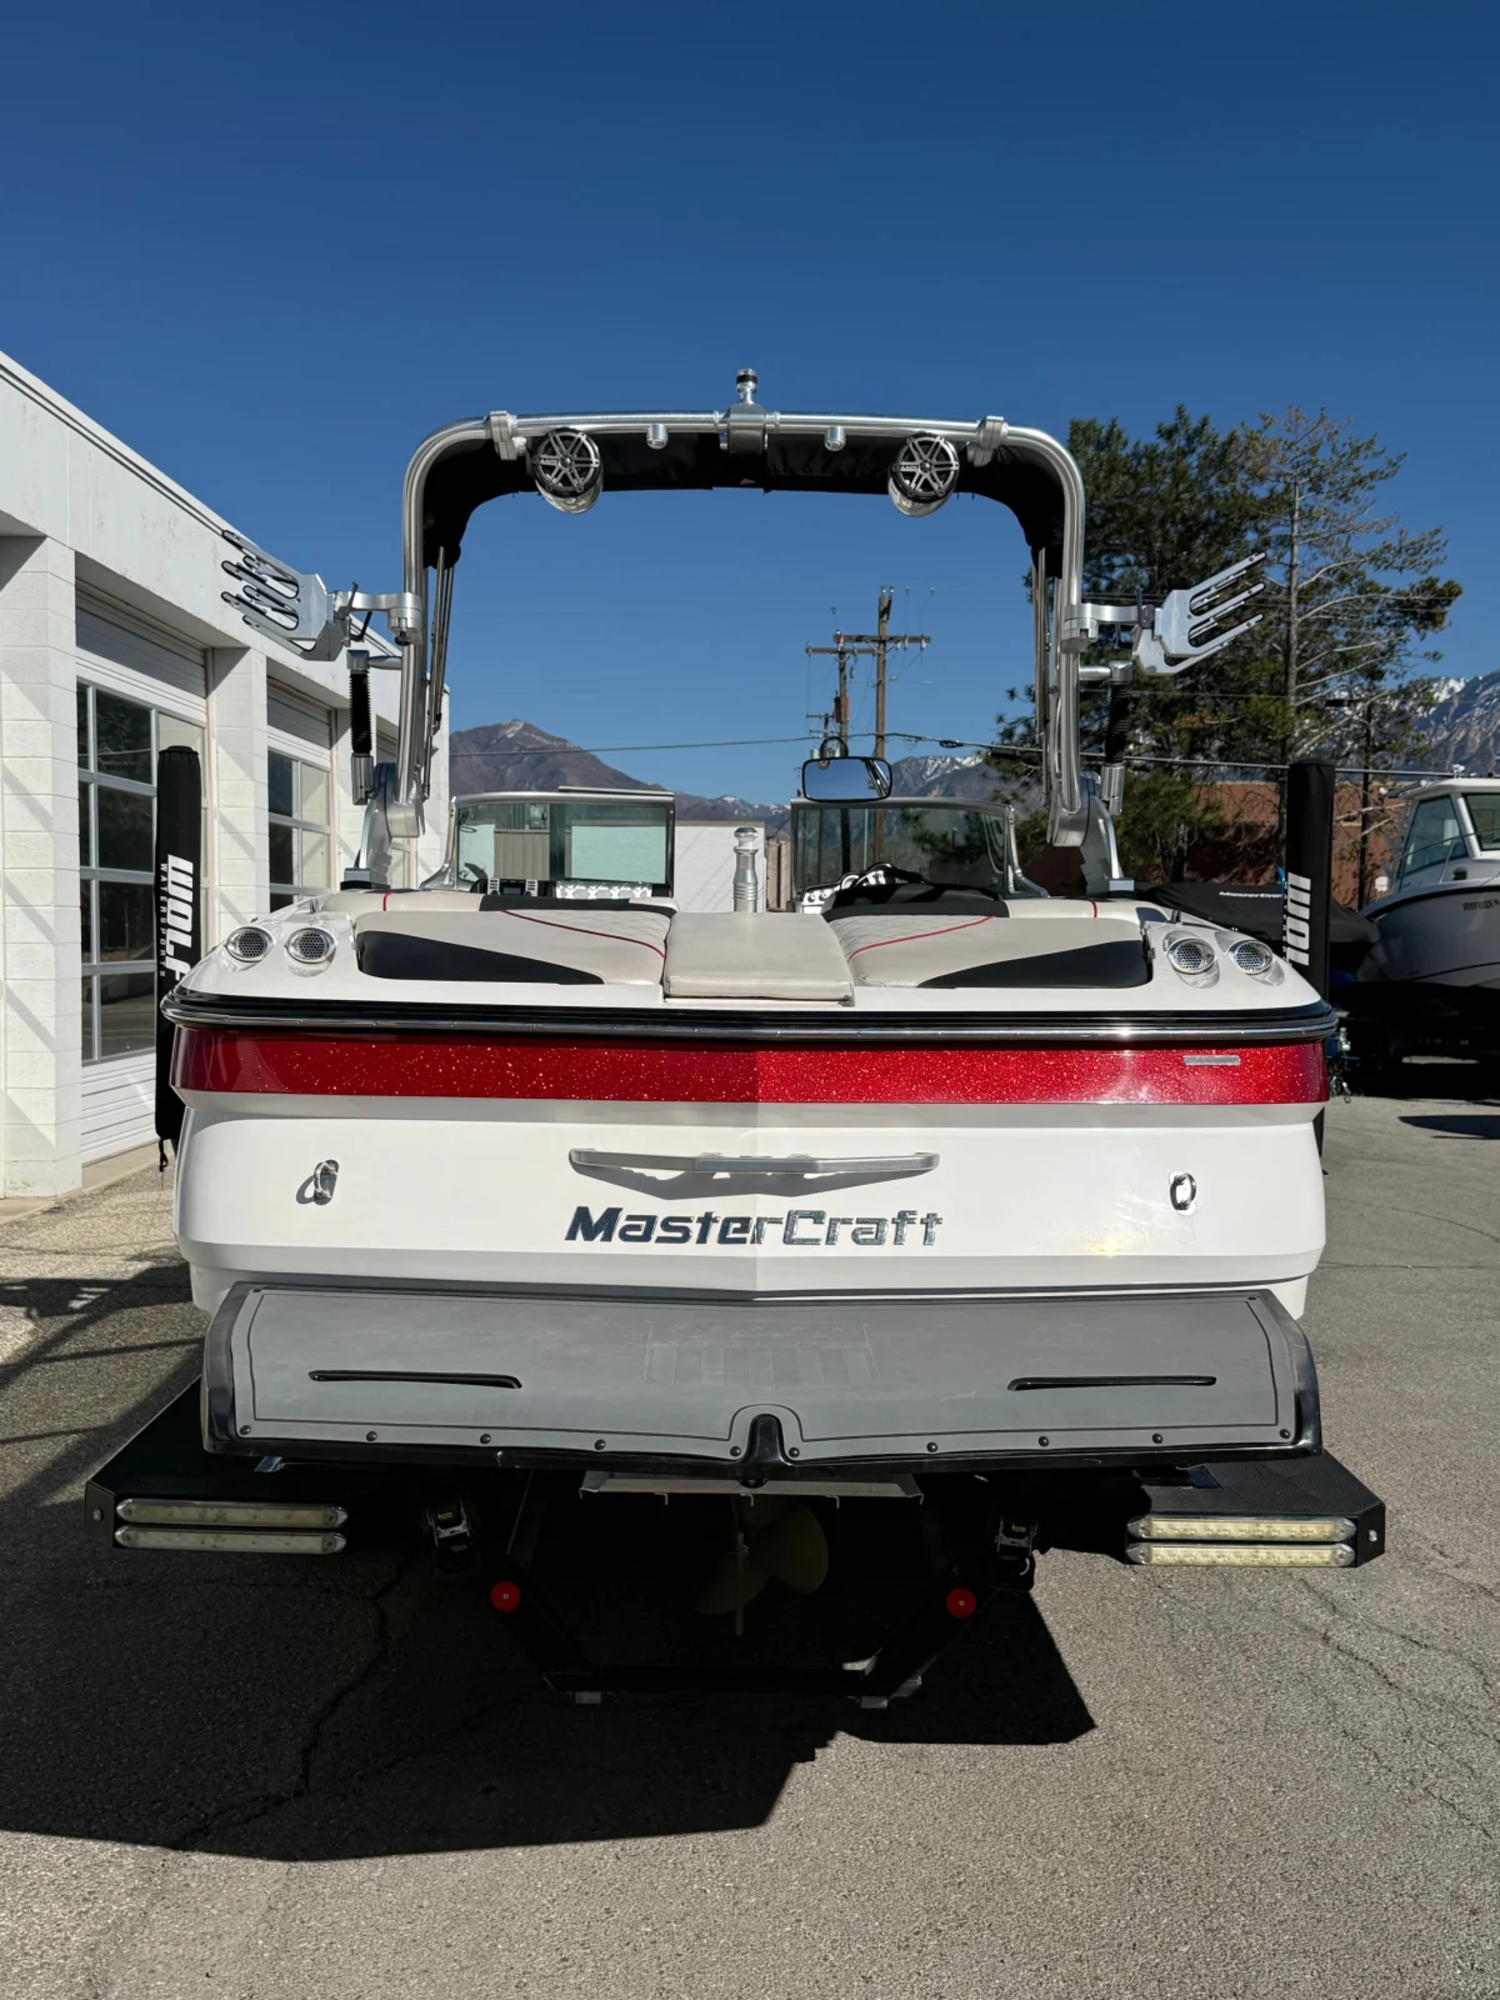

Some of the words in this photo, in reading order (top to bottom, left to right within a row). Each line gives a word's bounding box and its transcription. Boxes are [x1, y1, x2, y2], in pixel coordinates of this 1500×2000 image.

[160, 863, 168, 977] WATERSPORTS
[165, 854, 194, 981] WOLF
[1286, 871, 1312, 966] WOL
[565, 1206, 943, 1247] MasterCraft
